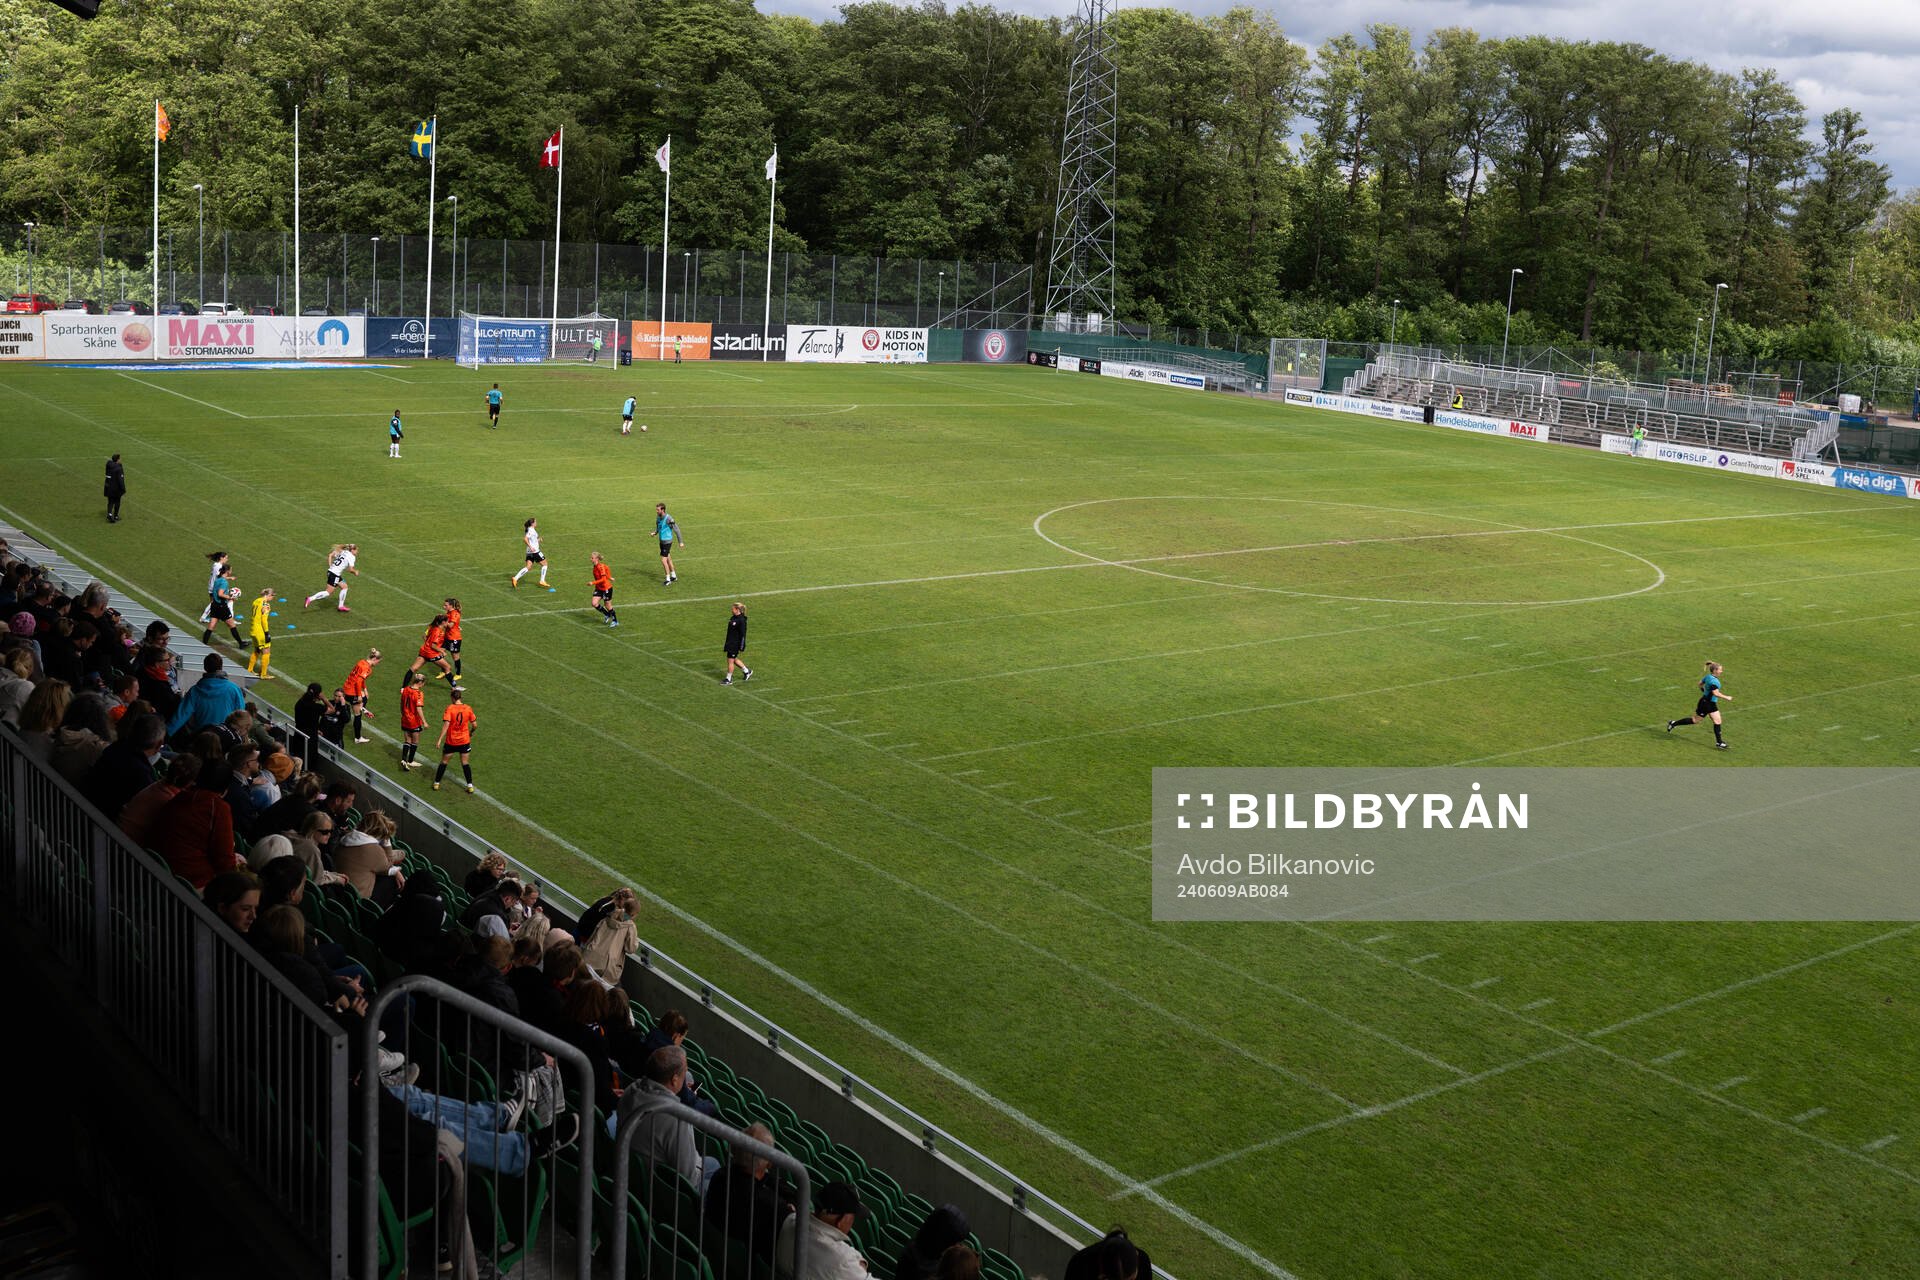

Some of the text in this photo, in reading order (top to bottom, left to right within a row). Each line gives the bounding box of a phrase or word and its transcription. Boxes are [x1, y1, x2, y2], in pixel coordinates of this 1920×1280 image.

[51, 323, 117, 337] Sparbanken
[168, 319, 255, 346] MAXI
[886, 331, 923, 340] KIDS IN
[83, 337, 117, 348] Skåne
[279, 330, 316, 346] ABK
[712, 332, 785, 351] stadium
[797, 329, 833, 355] Telarco
[185, 347, 255, 356] STORMARKNAD
[882, 341, 925, 351] MOTION
[1435, 413, 1498, 432] Handelsbanken
[1509, 421, 1537, 437] MAXI
[1658, 449, 1708, 463] MOTORSLIP
[1795, 472, 1809, 480] SPEL
[1796, 465, 1825, 476] SVENSKA
[1843, 471, 1897, 491] Heja dig!
[455, 711, 463, 726] 9
